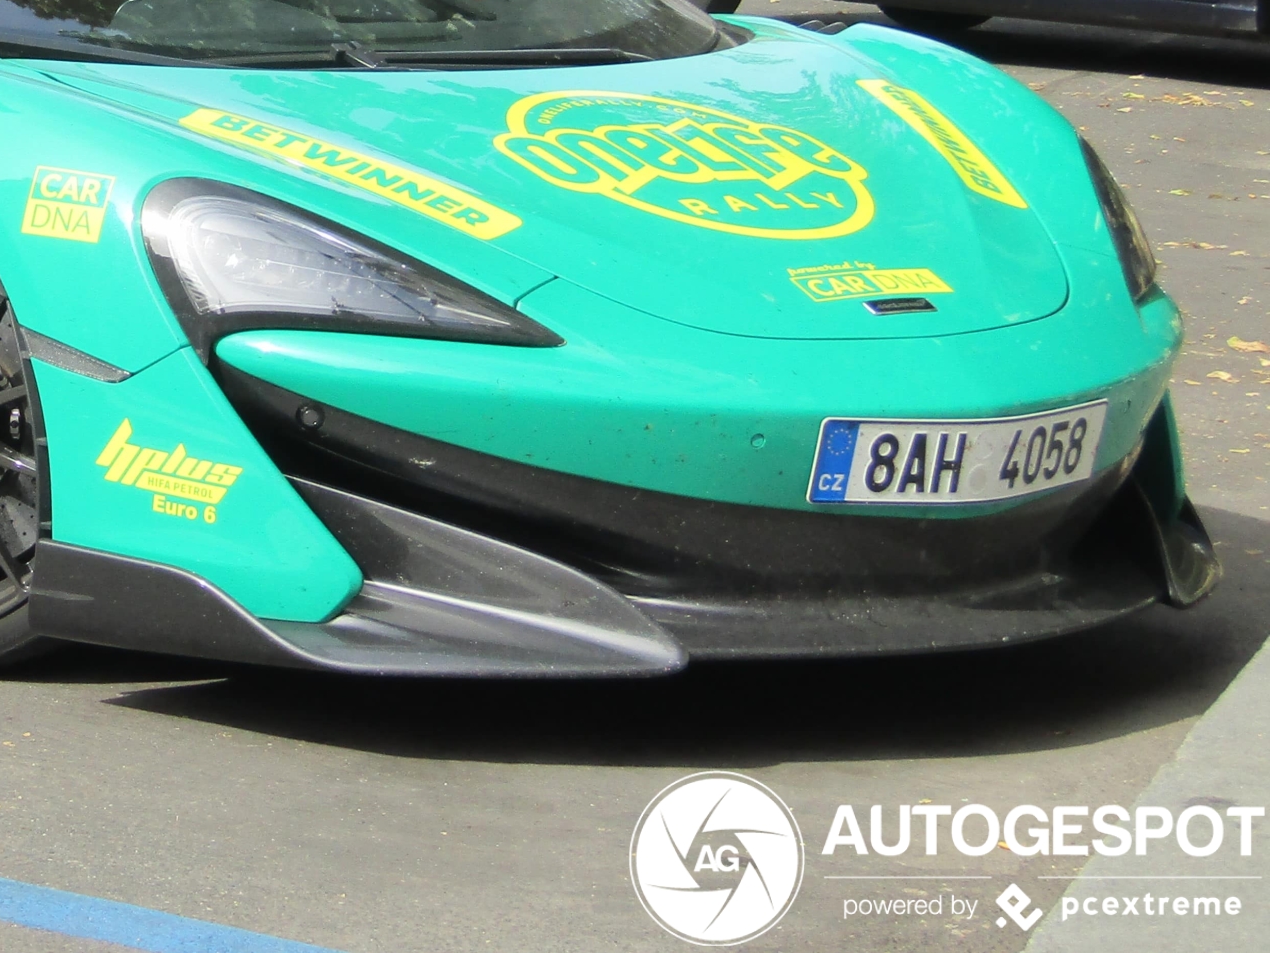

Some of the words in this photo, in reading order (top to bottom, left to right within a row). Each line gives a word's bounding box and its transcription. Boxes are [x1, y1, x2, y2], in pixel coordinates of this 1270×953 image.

[211, 115, 490, 227] BETWINNER
[38, 172, 102, 204] CAR
[677, 191, 845, 217] RALLY
[29, 205, 92, 235] DNA
[786, 261, 854, 277] powered
[853, 260, 876, 271] by
[807, 275, 876, 296] CAR
[872, 273, 942, 290] DNA
[864, 431, 968, 494] 8AH
[999, 417, 1088, 489] 4058
[147, 475, 171, 490] HIFA
[173, 481, 213, 499] PETROL
[818, 473, 843, 491] CZ
[152, 493, 198, 520] Euro
[202, 505, 217, 524] 6
